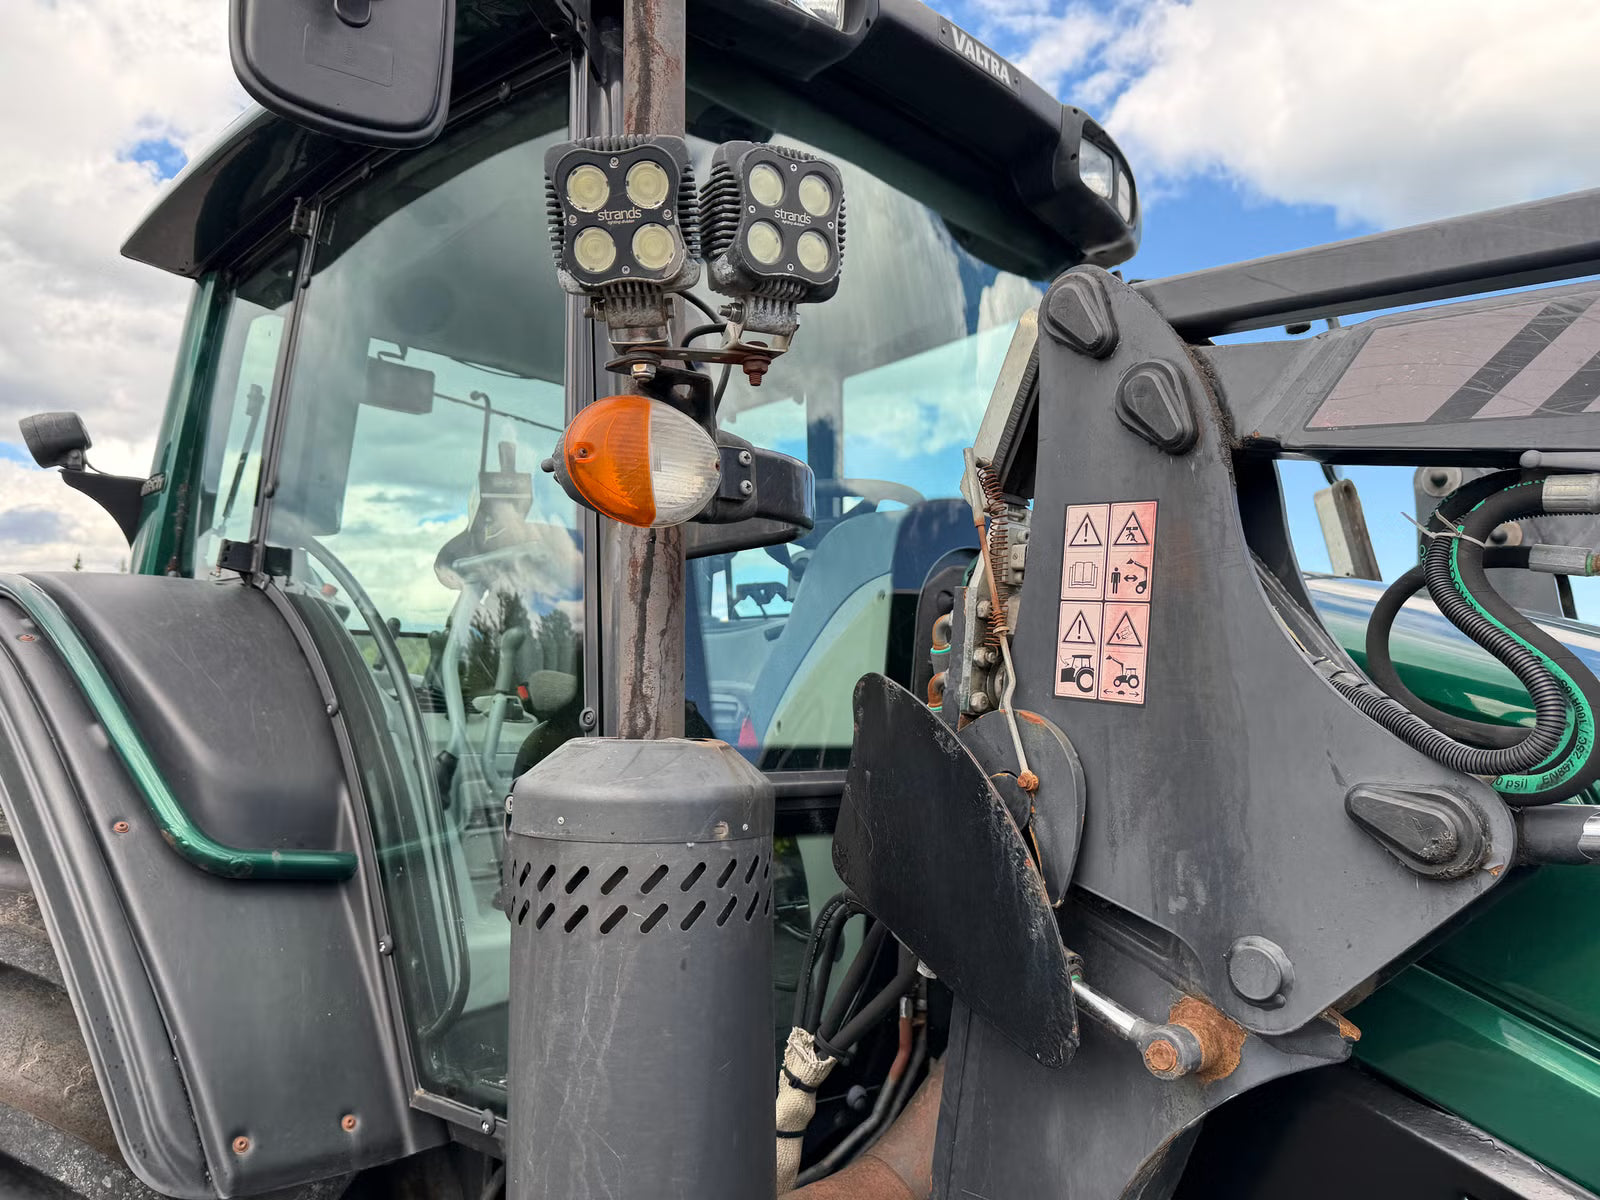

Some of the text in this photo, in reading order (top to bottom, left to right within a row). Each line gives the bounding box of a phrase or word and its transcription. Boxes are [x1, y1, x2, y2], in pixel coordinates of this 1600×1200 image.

[951, 26, 1011, 86] VALTRA
[597, 207, 642, 221] strands
[774, 208, 812, 224] strands
[1573, 737, 1587, 760] 2SC
